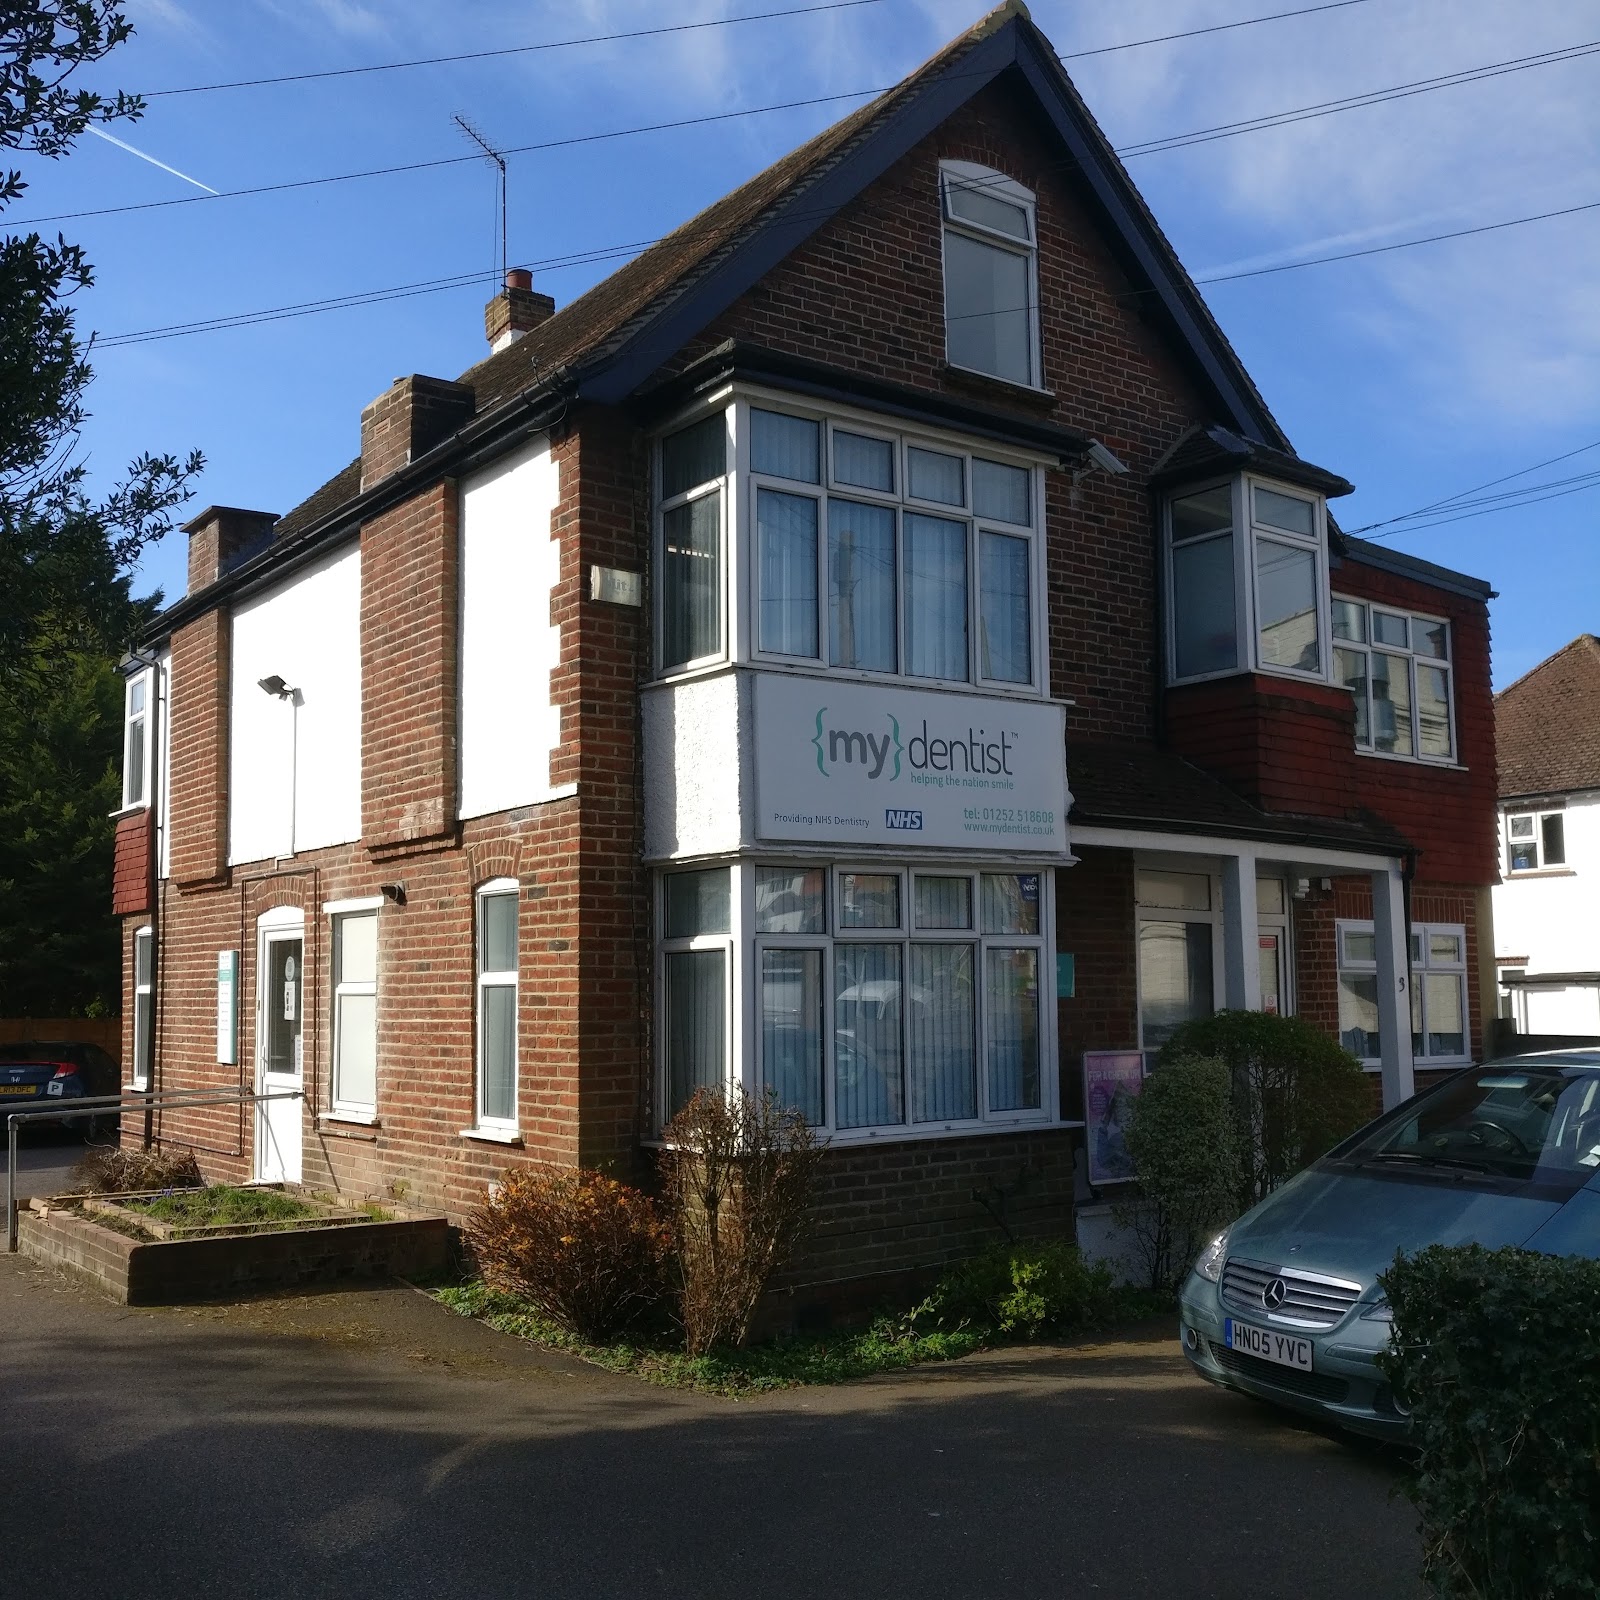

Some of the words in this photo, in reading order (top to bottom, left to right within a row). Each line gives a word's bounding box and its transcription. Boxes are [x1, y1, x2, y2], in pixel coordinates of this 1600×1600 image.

[910, 773, 944, 788] helping
[945, 775, 961, 787] the
[962, 777, 989, 788] nation
[992, 778, 1014, 790] smile
[774, 813, 813, 826] Providing
[815, 815, 832, 825] NHS
[834, 816, 870, 828] Dentistry
[886, 810, 922, 829] NHS
[963, 807, 980, 820] tel:
[983, 808, 1014, 821] 01252
[1017, 810, 1054, 823] 518608
[963, 823, 1055, 836] www.mydentist.co.uk
[1398, 977, 1405, 992] 3
[51, 1084, 59, 1093] P
[1234, 1324, 1270, 1355] HN05
[1275, 1336, 1308, 1365] YVC
